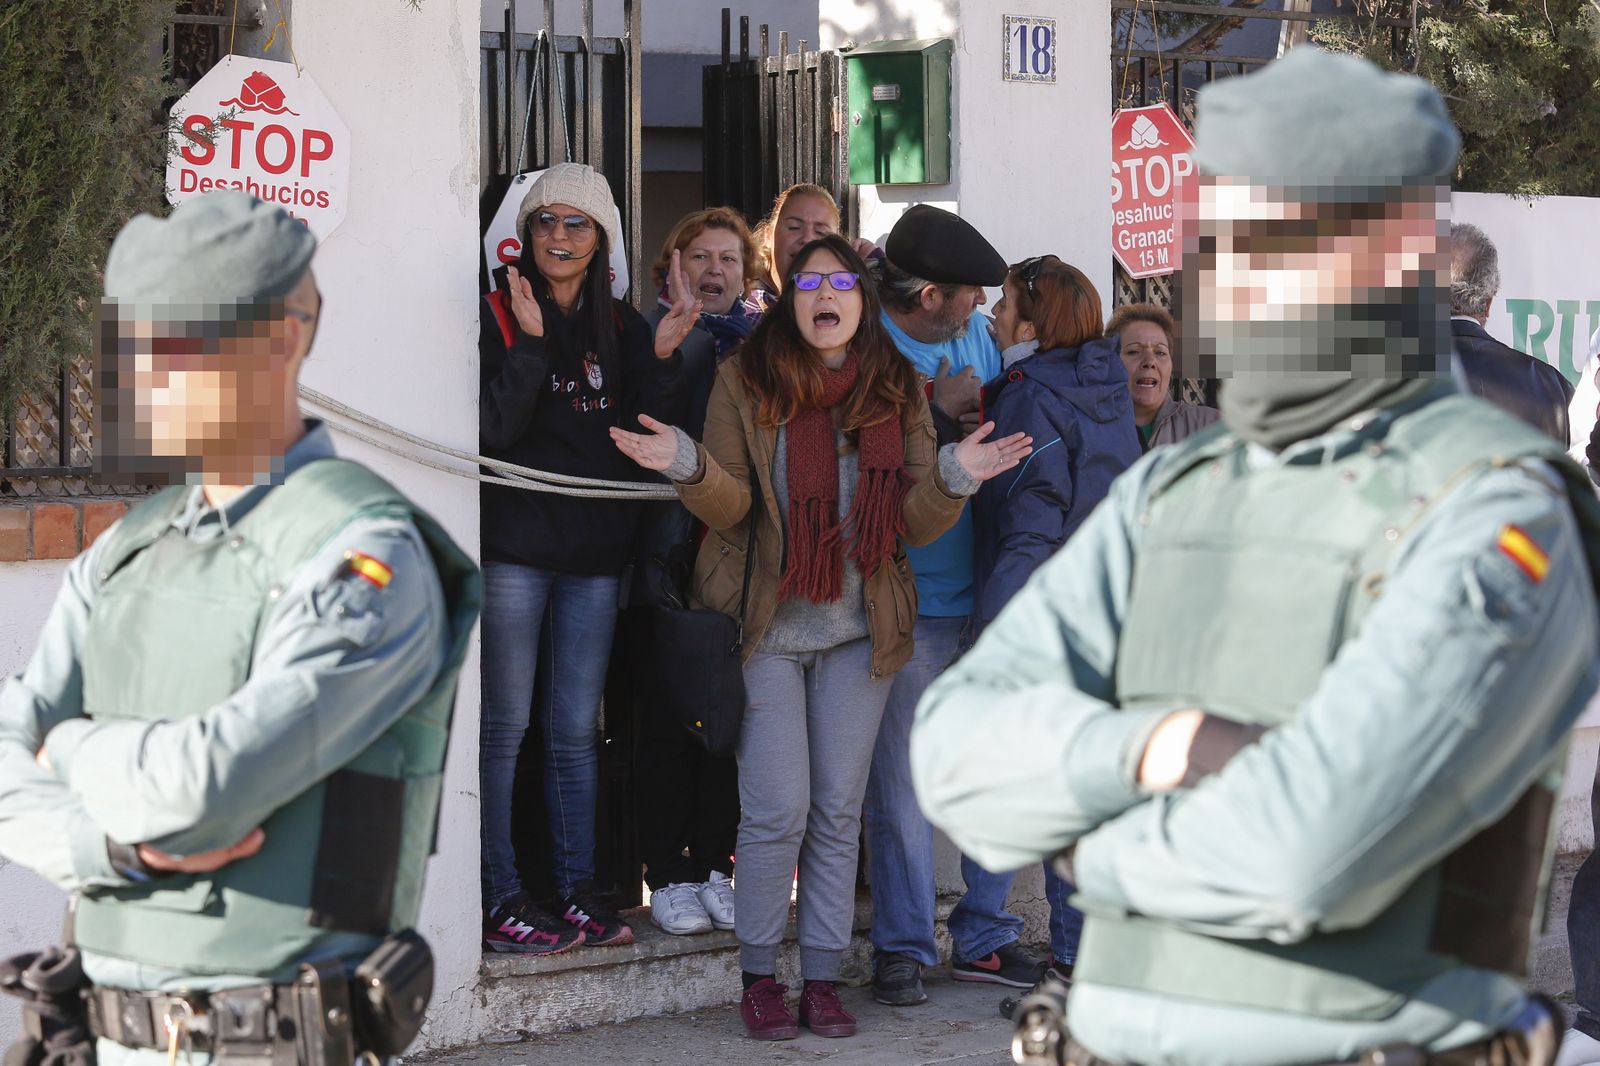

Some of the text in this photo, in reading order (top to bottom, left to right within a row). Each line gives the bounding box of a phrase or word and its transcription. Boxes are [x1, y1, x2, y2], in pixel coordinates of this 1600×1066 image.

[1013, 24, 1051, 75] 18
[180, 115, 334, 178] STOP
[179, 168, 330, 209] Desahucios
[1112, 152, 1193, 204] STOP
[1112, 199, 1175, 226] esahuc
[1118, 223, 1175, 251] Granad
[1139, 247, 1169, 268] 15 M
